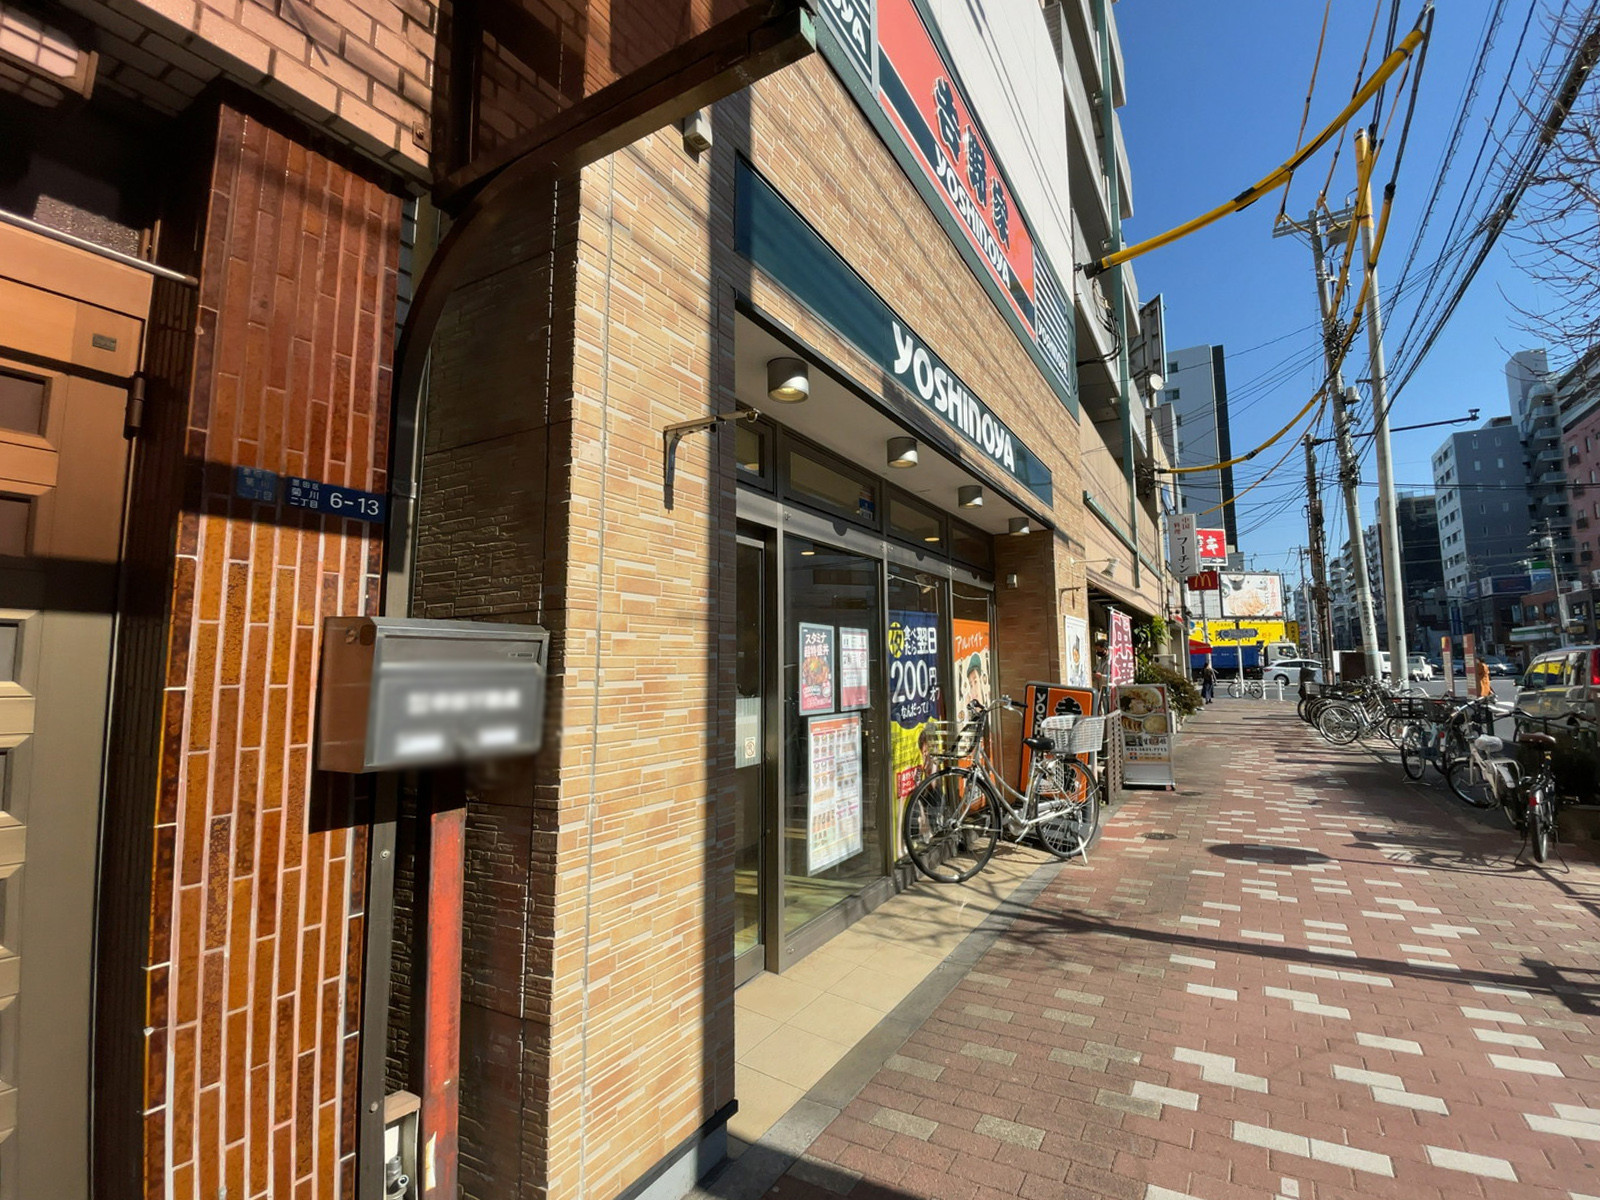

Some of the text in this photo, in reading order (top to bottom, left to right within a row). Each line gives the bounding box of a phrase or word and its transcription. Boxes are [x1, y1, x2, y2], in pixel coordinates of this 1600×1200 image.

[935, 143, 1011, 290] YOSHINOYA
[892, 320, 1015, 474] YOSHINOYA
[330, 492, 379, 516] 6-13
[1177, 536, 1190, 574] フーチン
[805, 632, 827, 645] スタミナ
[890, 659, 929, 703] 200
